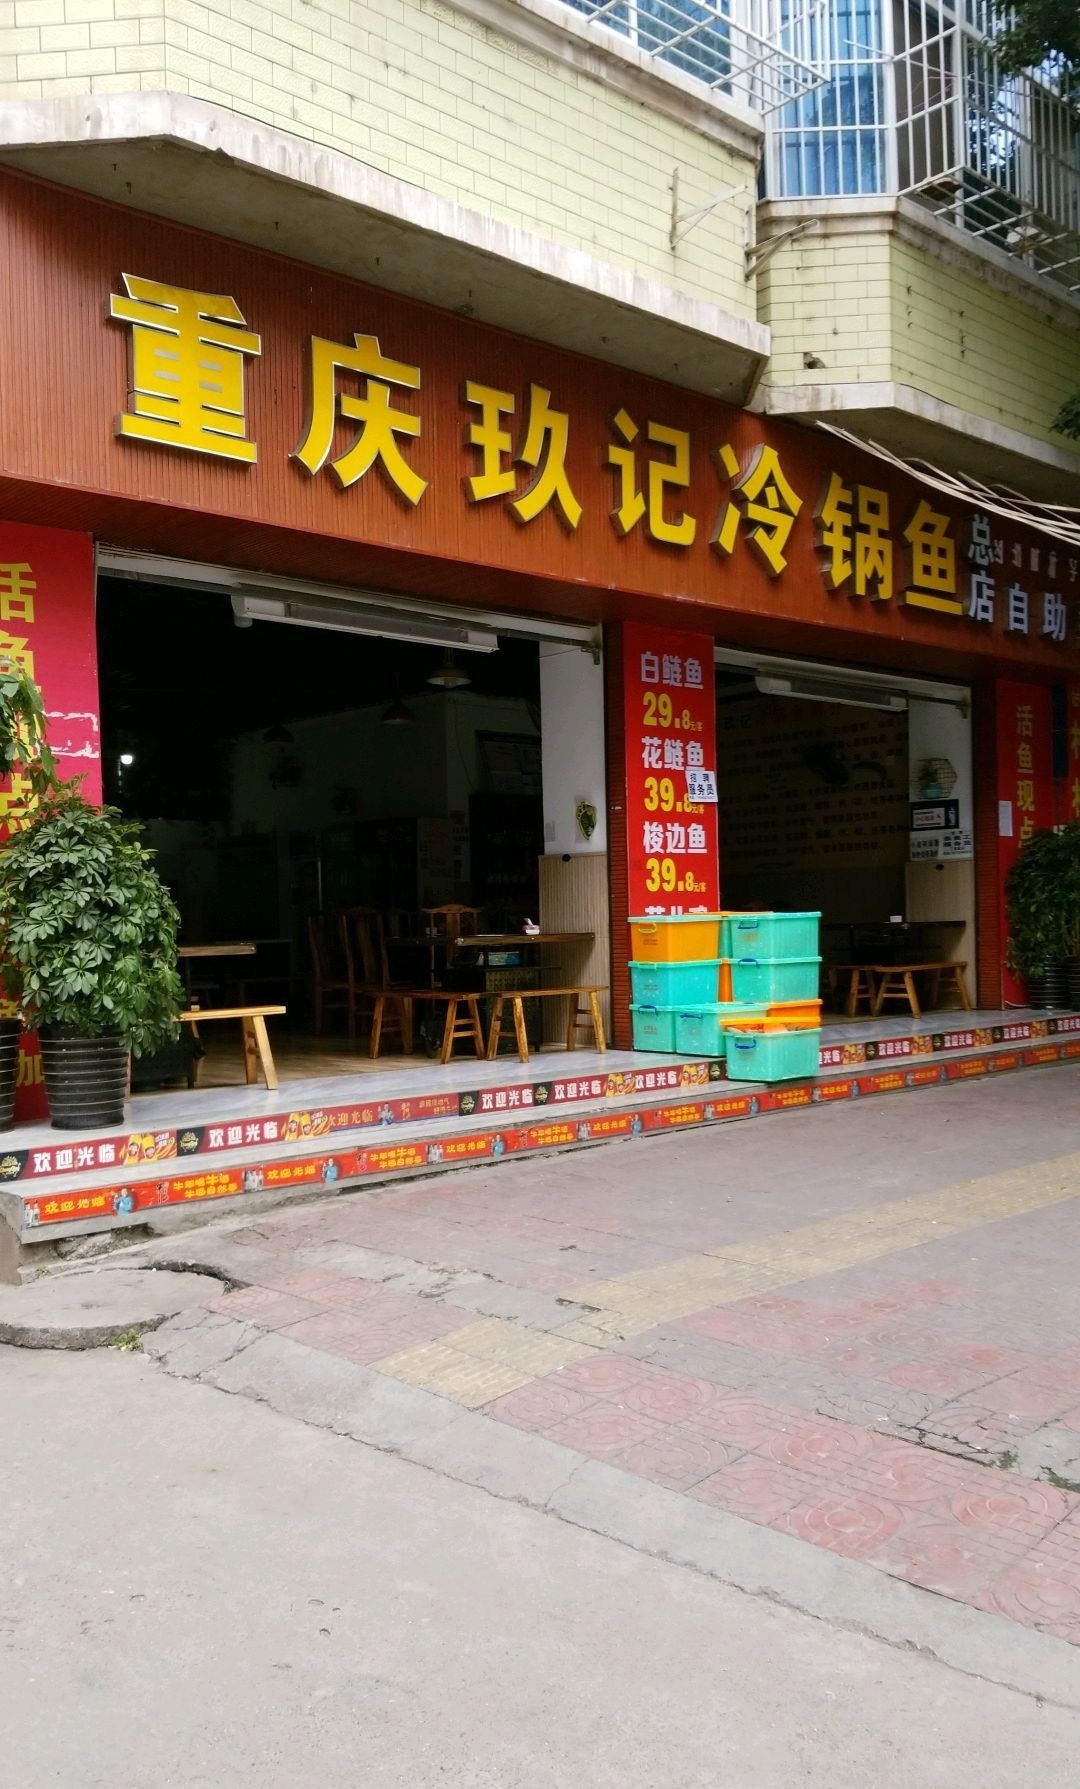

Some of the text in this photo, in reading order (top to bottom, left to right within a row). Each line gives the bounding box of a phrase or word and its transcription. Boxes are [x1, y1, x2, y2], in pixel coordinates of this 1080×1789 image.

[107, 272, 963, 616] 重庆玖记冷锅鱼
[968, 513, 995, 623] 总店
[1008, 582, 1067, 641] 自助
[641, 651, 704, 689] 白鲢鱼
[641, 735, 706, 771] 花鲢鱼
[689, 783, 714, 796] 服务员
[643, 820, 707, 853] 梭边鱼
[944, 1033, 973, 1048] 欢迎光临
[1003, 1025, 1030, 1040] 欢迎光临
[878, 1040, 910, 1057] 欢迎光临
[554, 1080, 602, 1100] 欢迎光临
[635, 1070, 678, 1090] 欢迎光临
[482, 1088, 534, 1110] 欢迎光临
[208, 1121, 279, 1148] 欢迎光临
[593, 1119, 627, 1131] 欢迎光临
[446, 1140, 486, 1153] 欢迎光临
[33, 1143, 116, 1173] 欢迎光临
[266, 1164, 316, 1180] 欢迎光临
[44, 1195, 106, 1214] 欢迎光临
